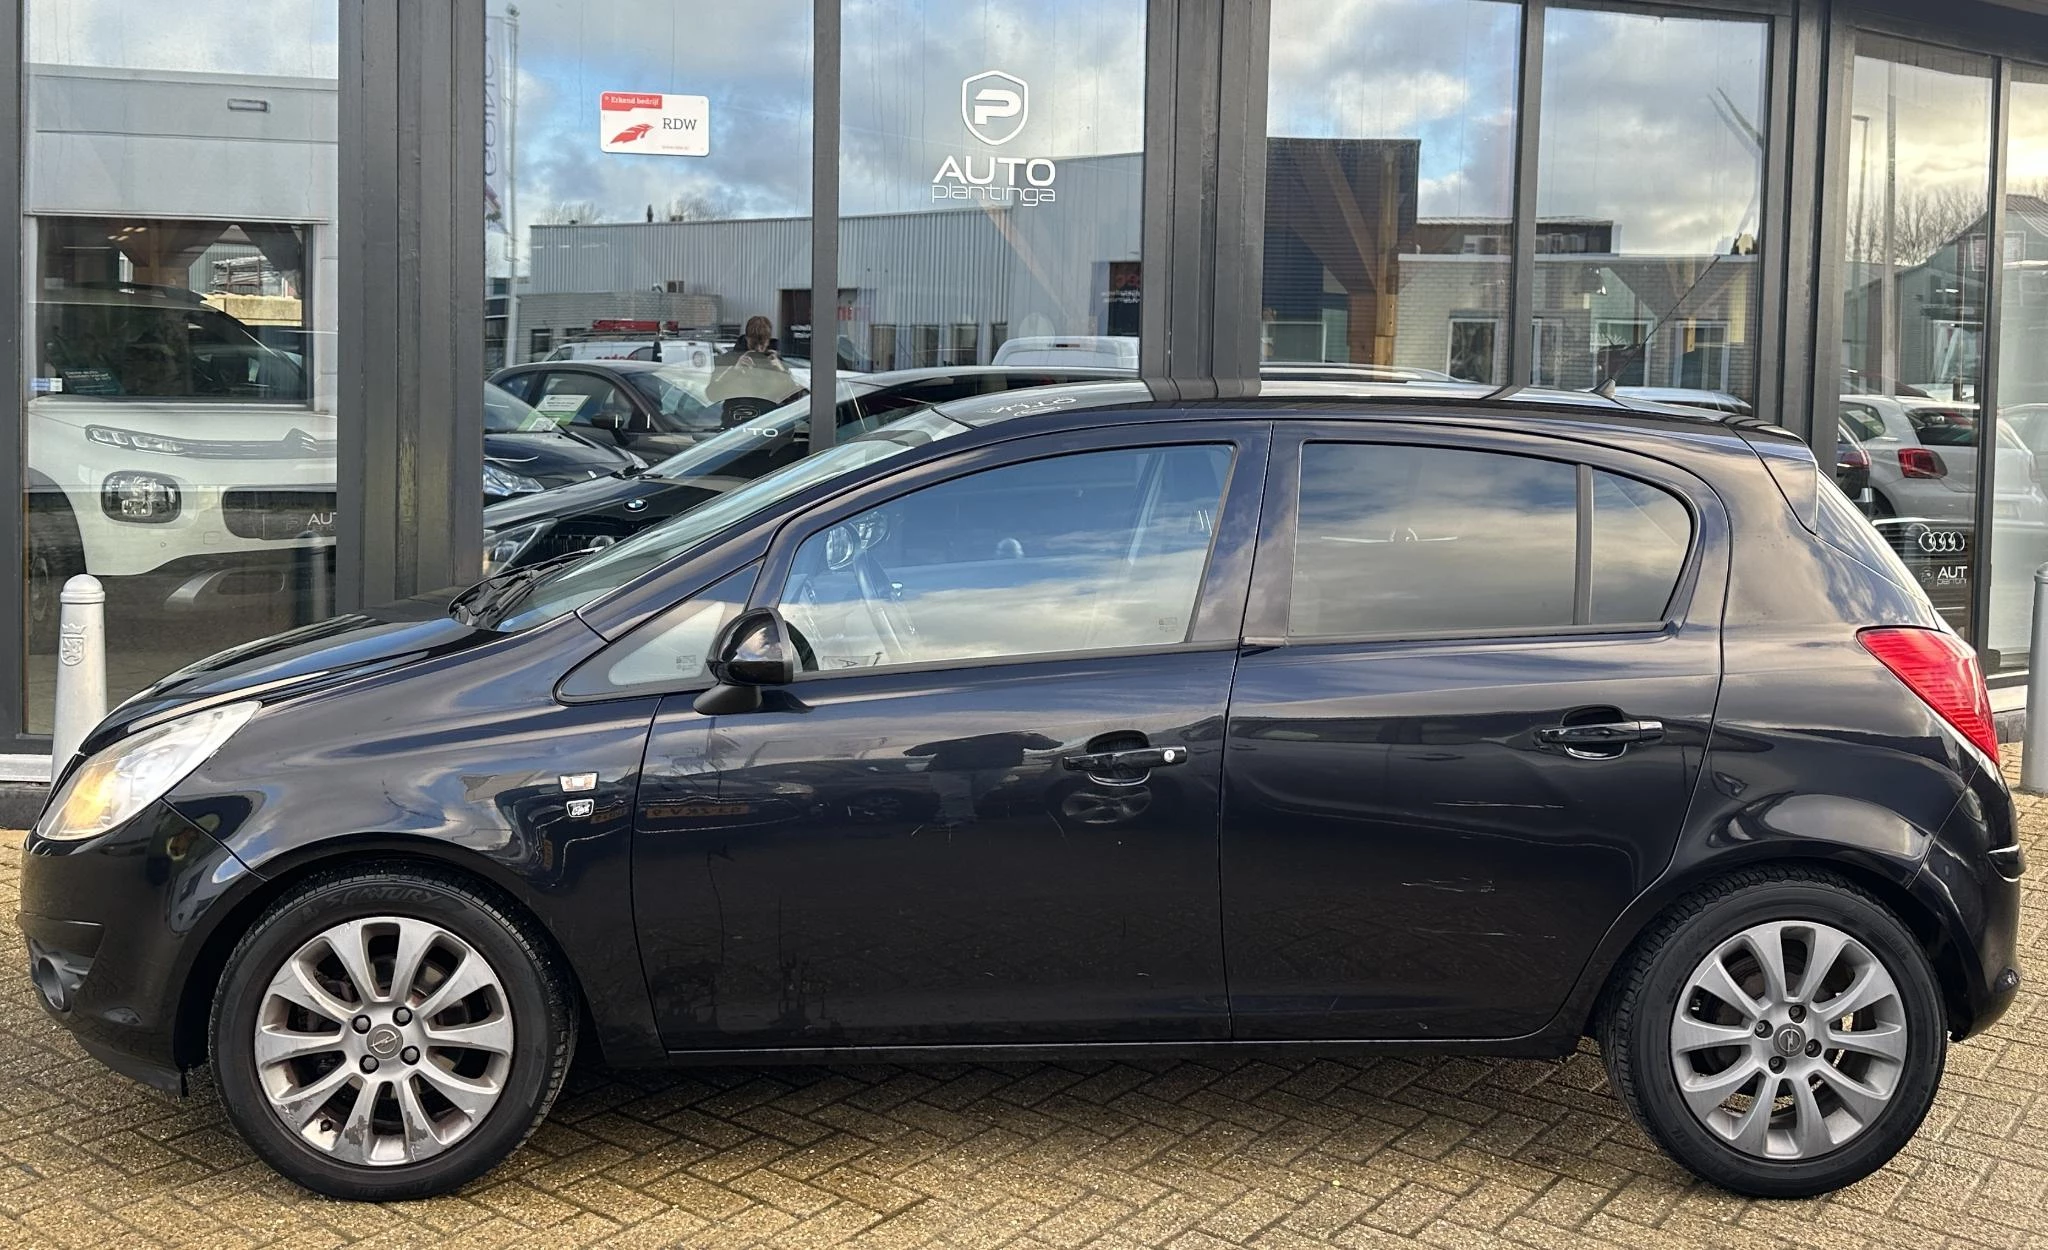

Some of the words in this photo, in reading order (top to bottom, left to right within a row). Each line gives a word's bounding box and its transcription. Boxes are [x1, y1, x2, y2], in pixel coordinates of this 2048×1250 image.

[611, 96, 636, 104] Erkend
[637, 97, 659, 106] bedrijf
[974, 88, 1022, 125] P
[662, 118, 697, 131] RDW
[932, 155, 1056, 187] AUTO
[931, 182, 1056, 207] plantinga
